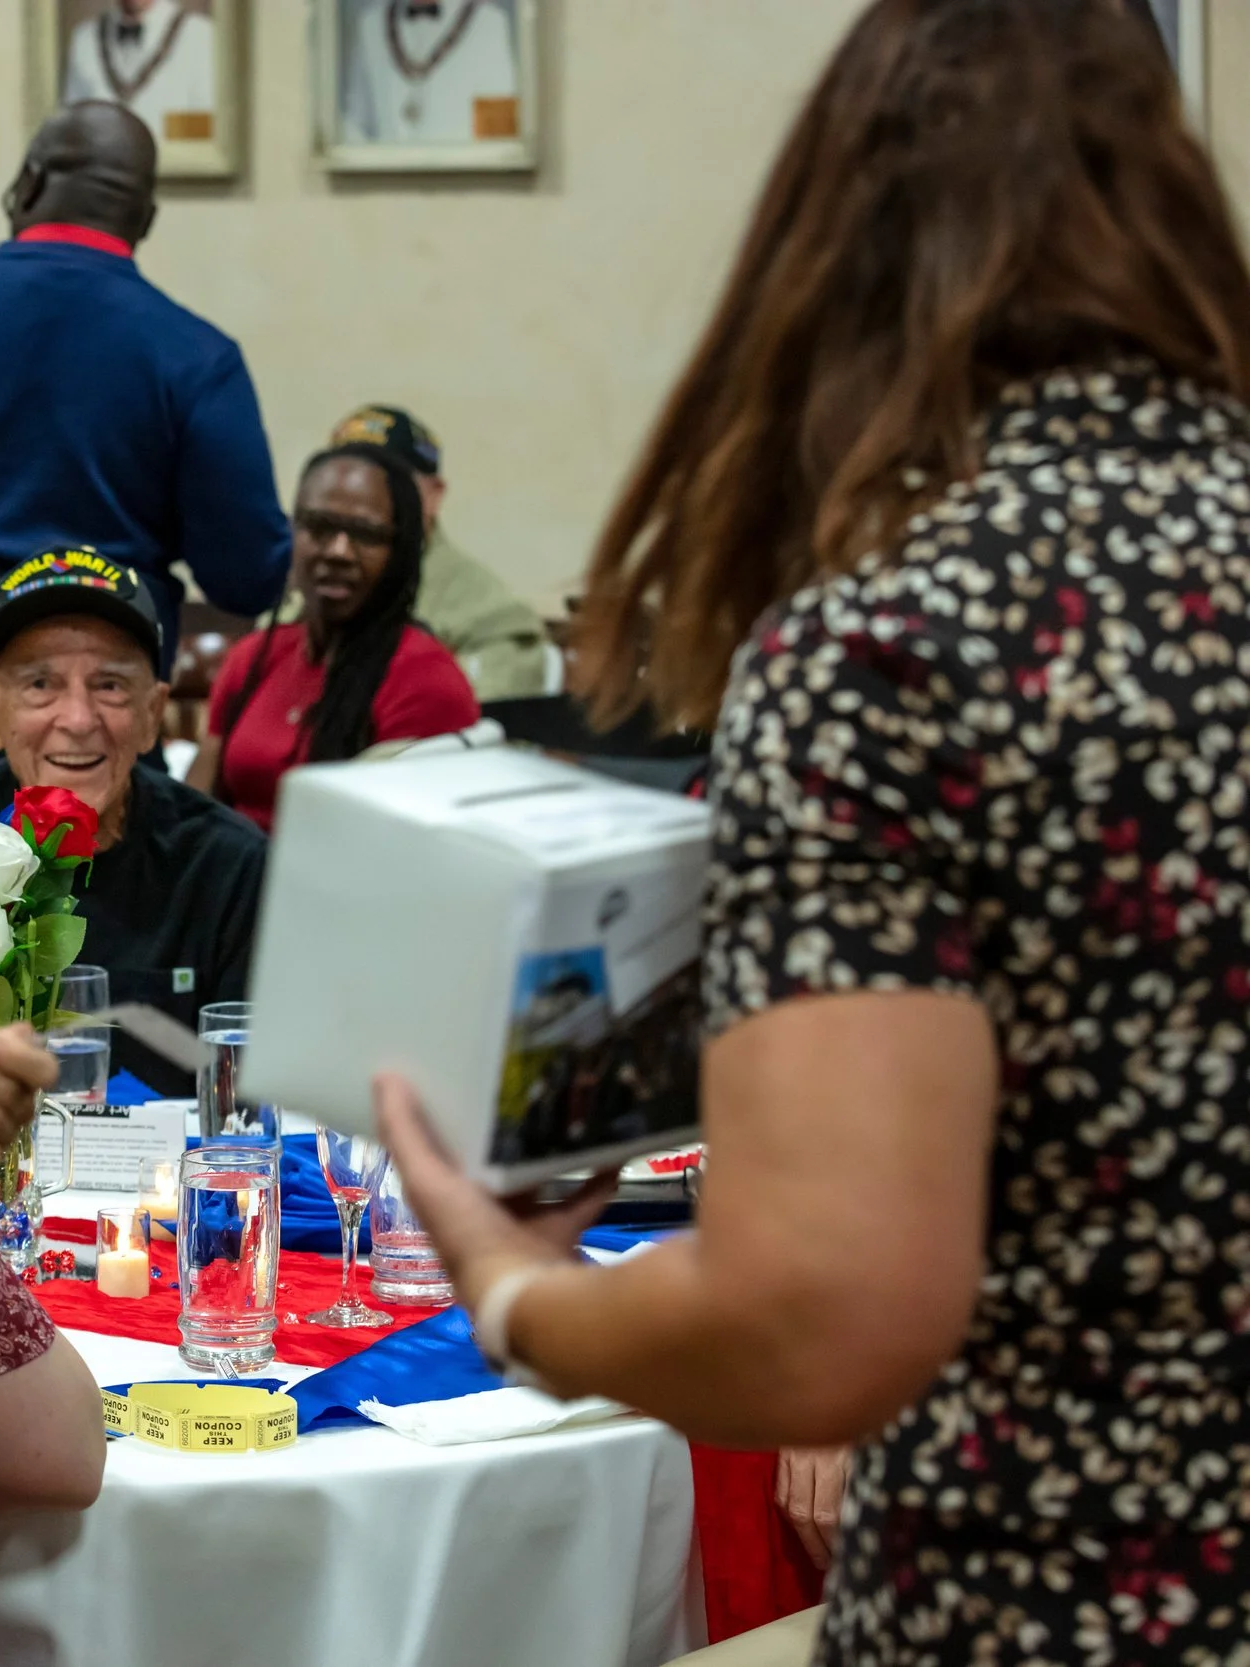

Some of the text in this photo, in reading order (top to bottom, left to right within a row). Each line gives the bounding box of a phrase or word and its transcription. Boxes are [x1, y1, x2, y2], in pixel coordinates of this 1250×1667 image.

[1, 553, 56, 590] WORLD
[65, 550, 106, 573] WAR
[110, 1105, 130, 1116] Art
[102, 1398, 128, 1412] COUPO
[107, 1408, 118, 1416] THIS
[142, 1411, 169, 1427] COUPON
[267, 1413, 294, 1427] COUPON
[194, 1422, 242, 1430] COUPON
[146, 1428, 165, 1440] KEEP
[181, 1420, 189, 1446] 662005
[273, 1430, 291, 1441] KEEP
[203, 1437, 233, 1446] KEEP
